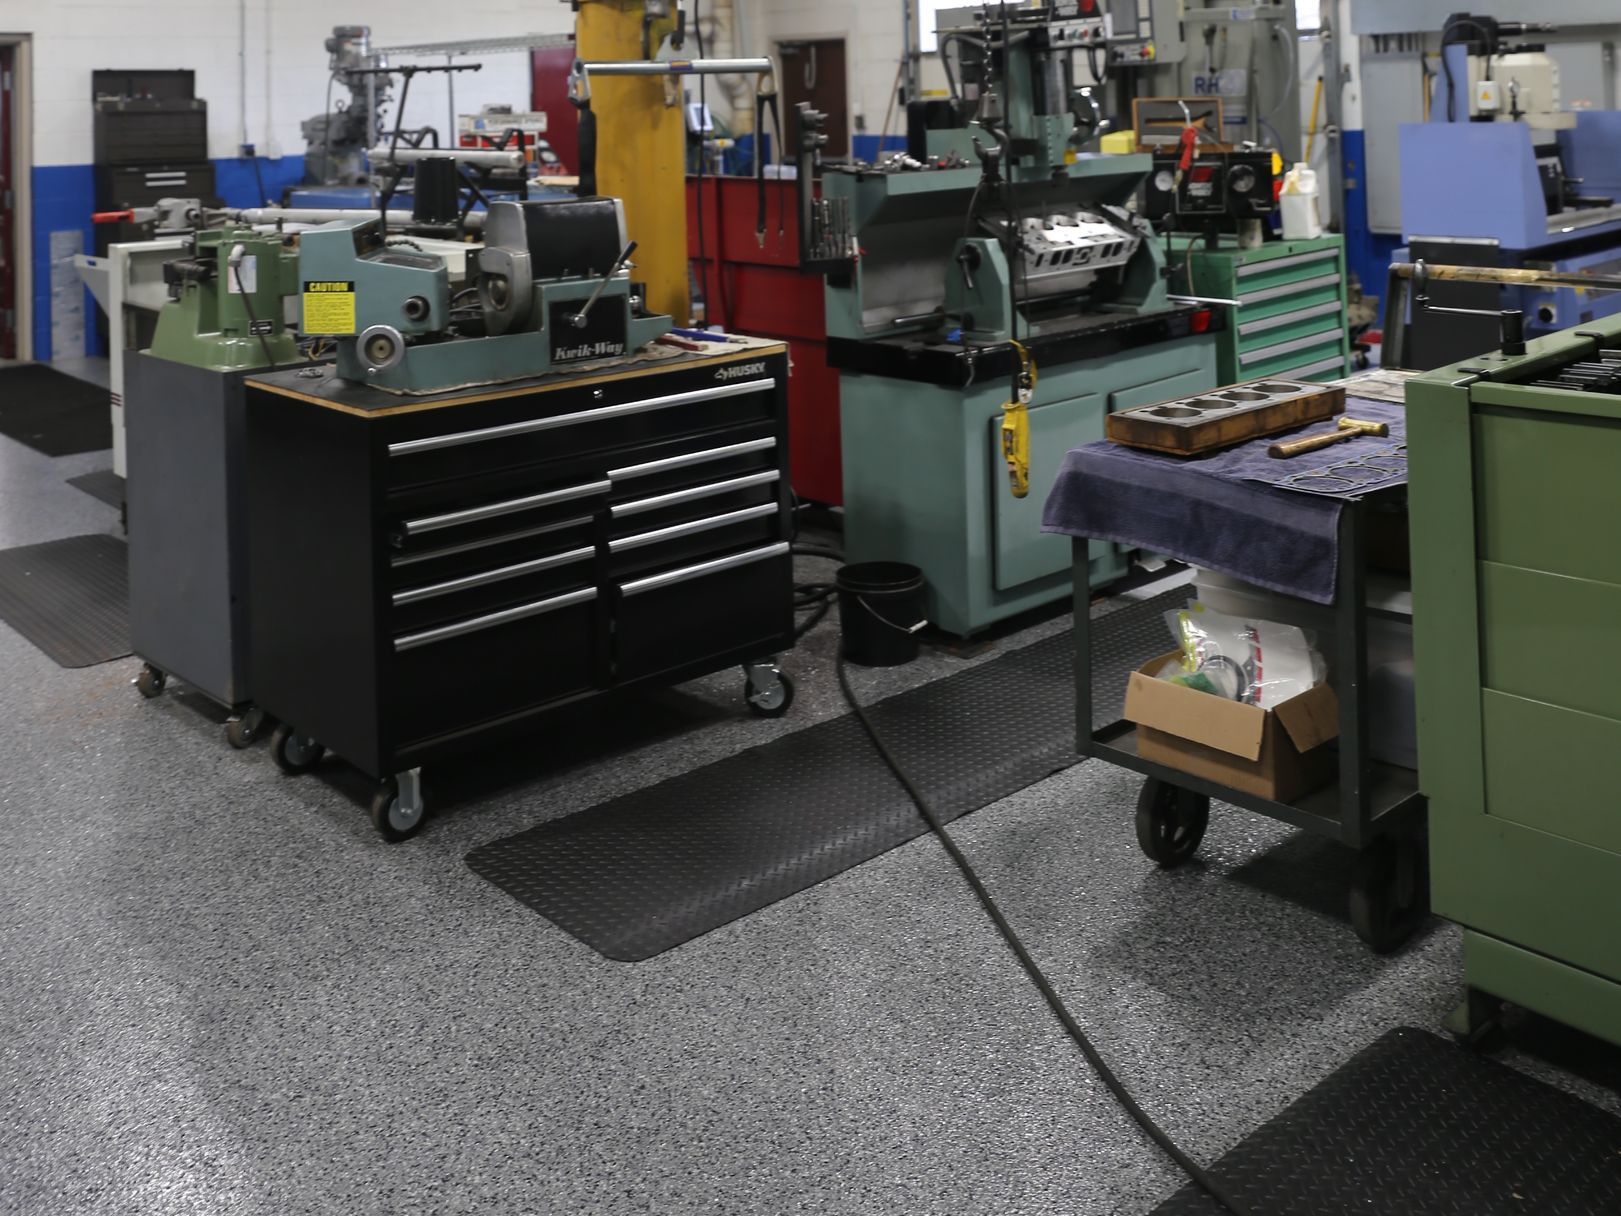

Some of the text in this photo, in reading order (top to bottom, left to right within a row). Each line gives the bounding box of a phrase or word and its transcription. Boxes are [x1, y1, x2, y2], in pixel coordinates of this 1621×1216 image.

[309, 282, 348, 291] CAUTION
[555, 341, 624, 360] Kwik-Way
[728, 362, 766, 378] HUSKY
